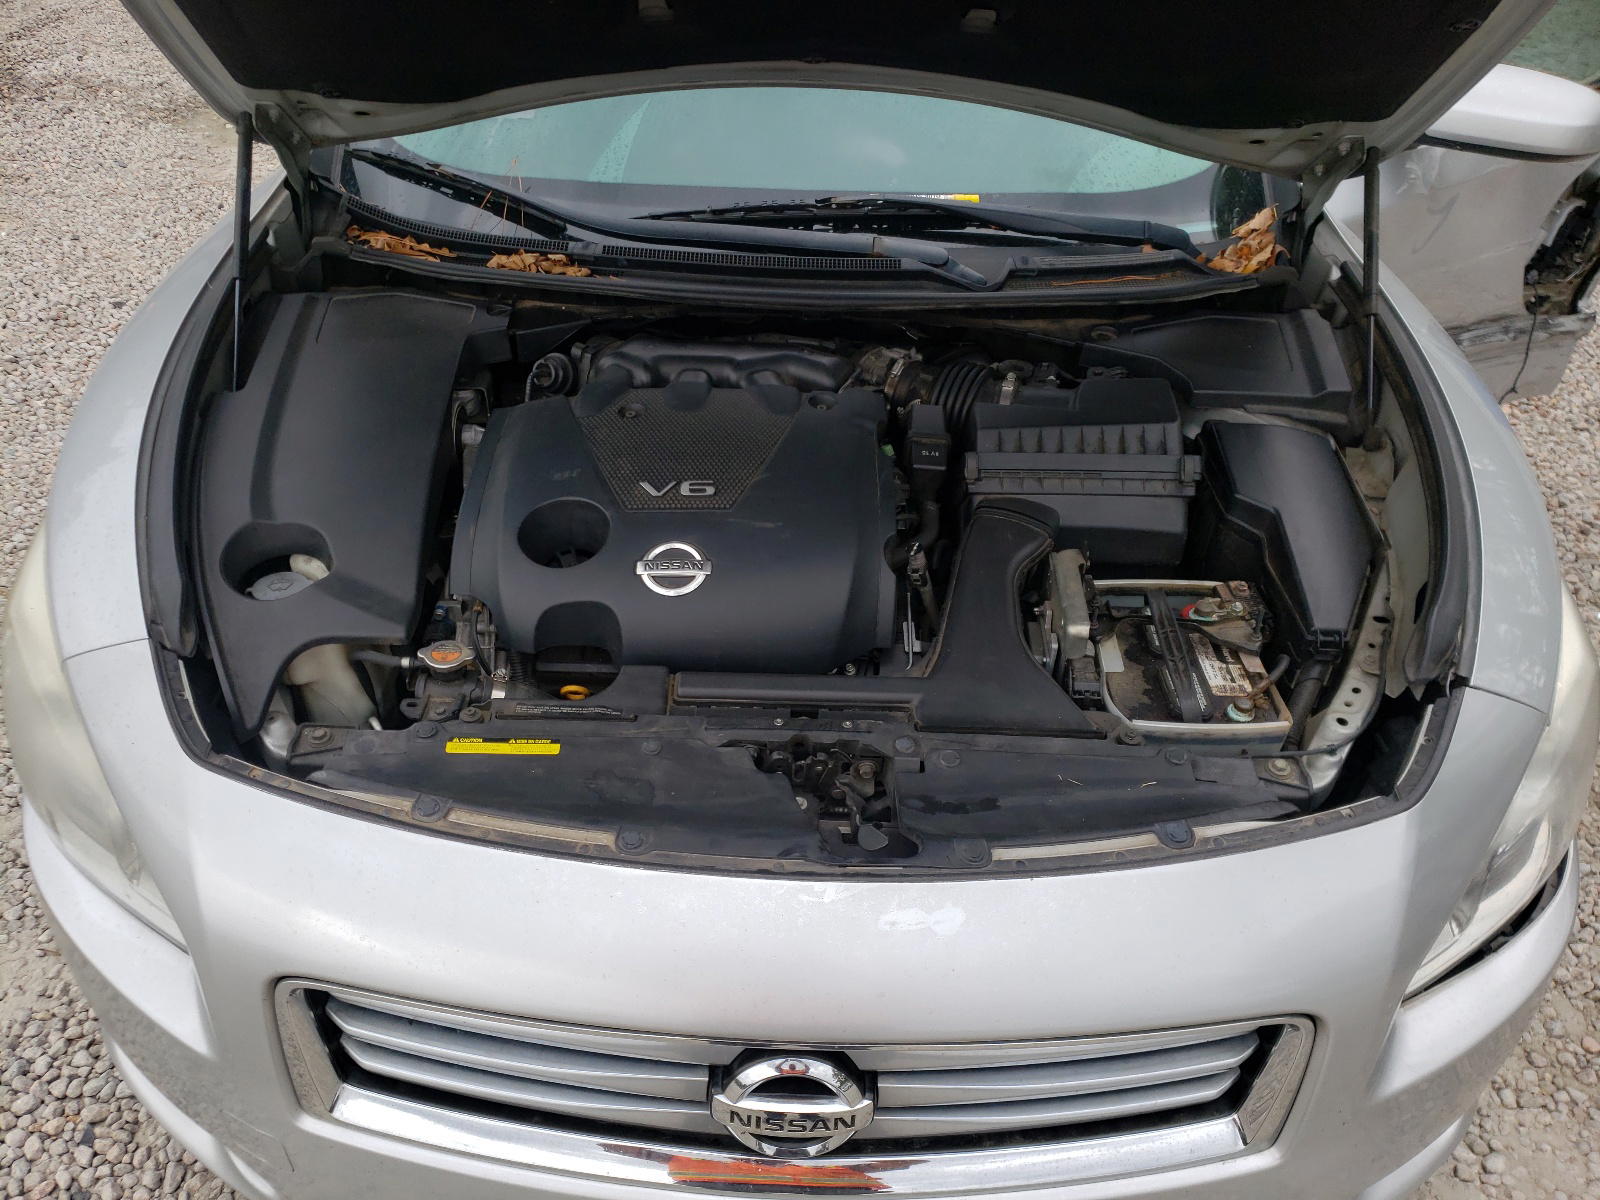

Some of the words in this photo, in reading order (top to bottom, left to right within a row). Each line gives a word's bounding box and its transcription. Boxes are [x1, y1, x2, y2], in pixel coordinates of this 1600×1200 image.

[639, 480, 716, 496] V6
[644, 560, 704, 571] NISSAN
[729, 1110, 857, 1133] NISSAN
